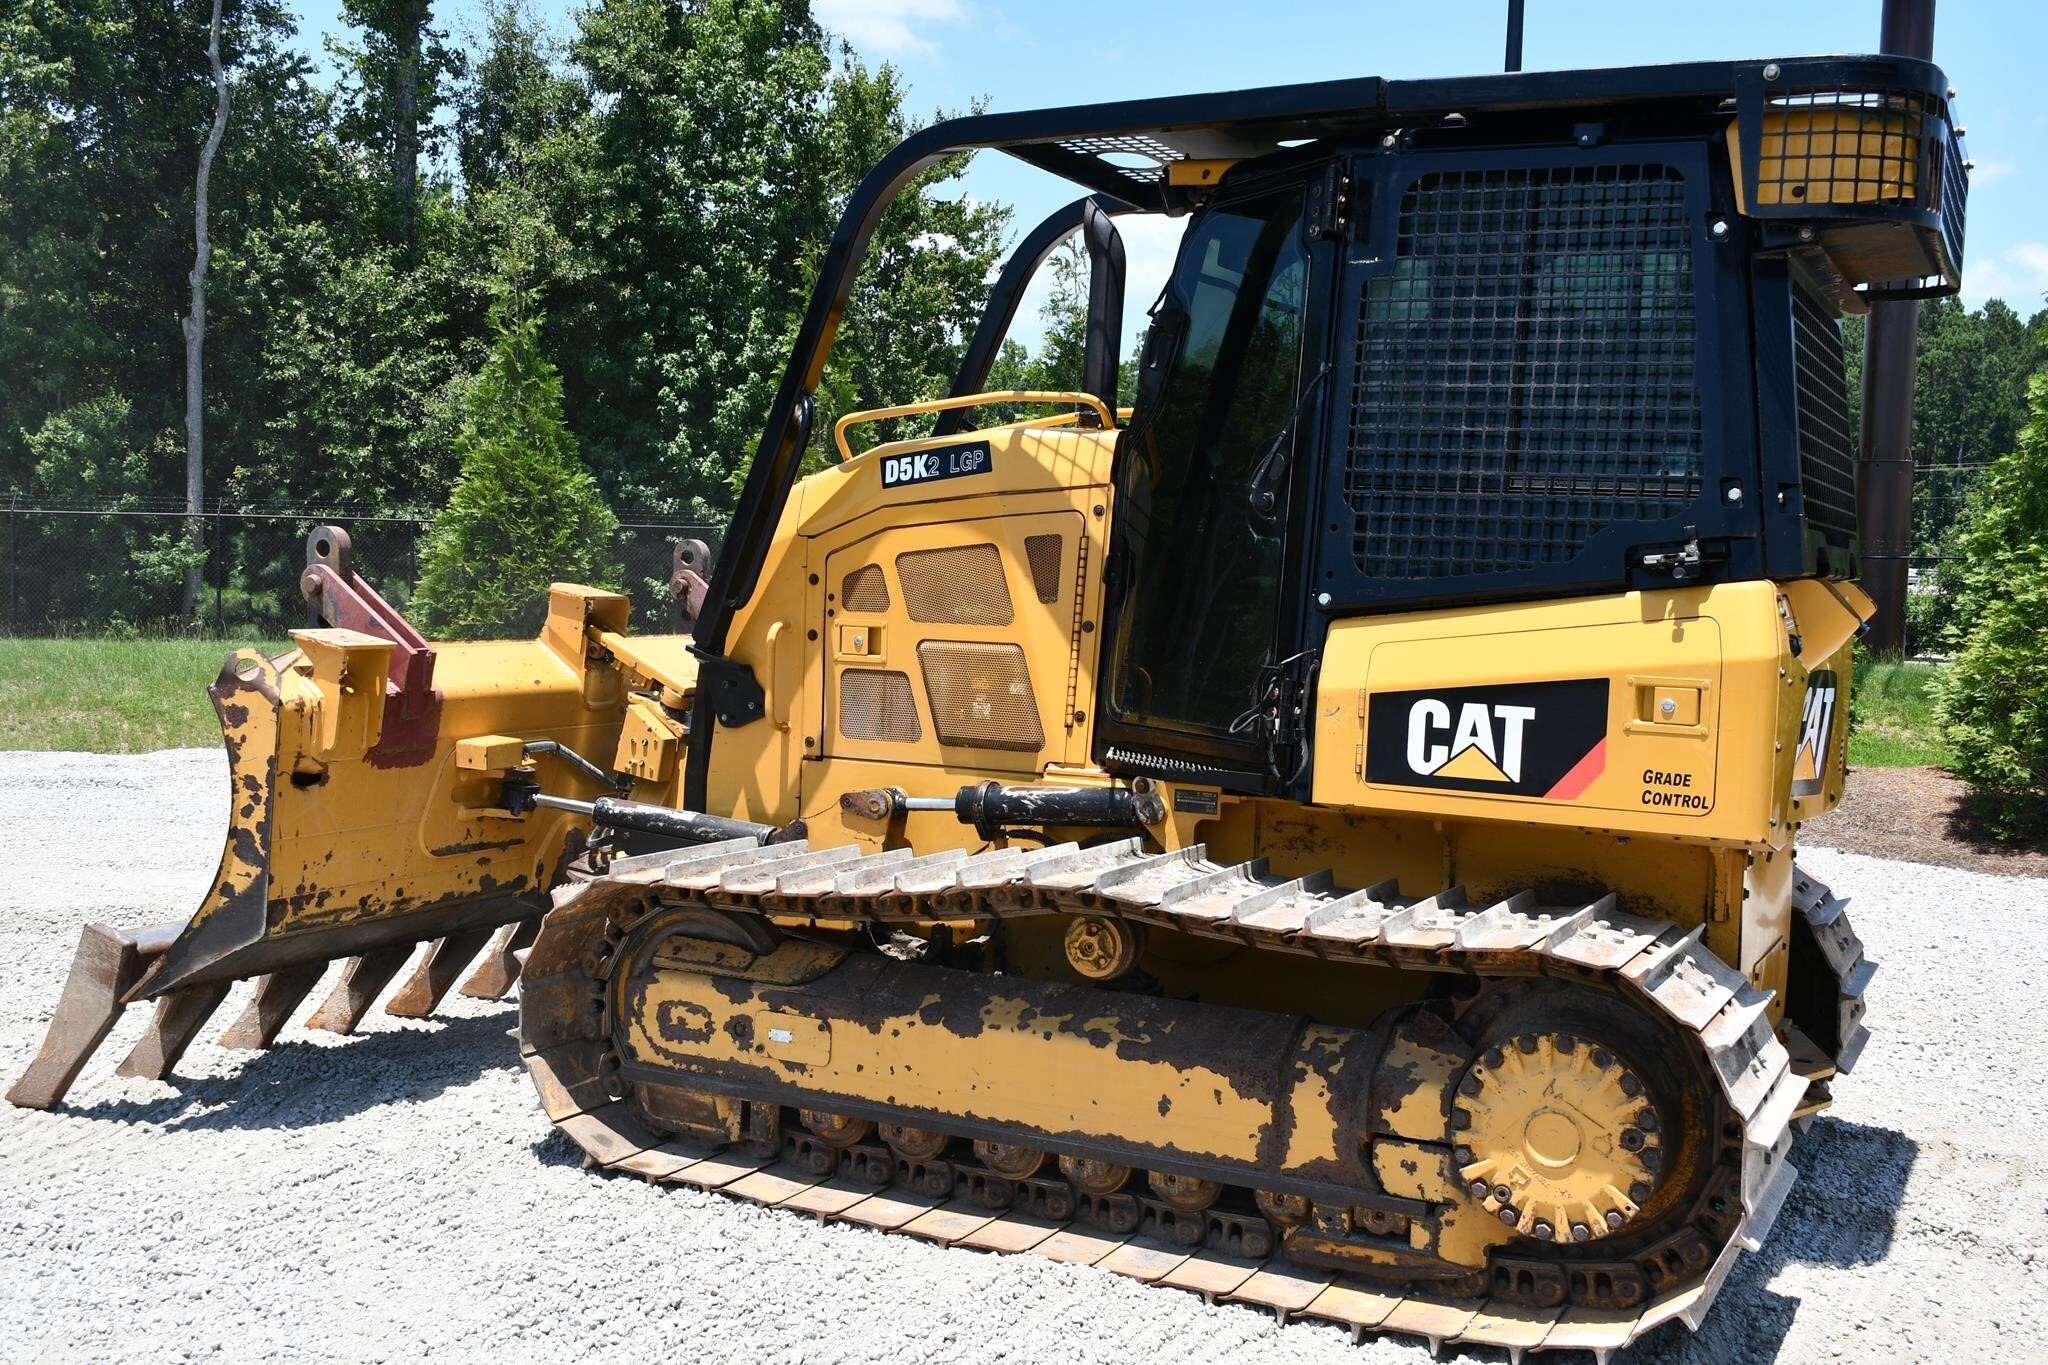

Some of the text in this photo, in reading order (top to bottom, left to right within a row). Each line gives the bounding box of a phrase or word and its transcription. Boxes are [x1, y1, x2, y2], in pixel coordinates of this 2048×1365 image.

[885, 449, 984, 484] D5K2 LGP
[1406, 698, 1536, 783] CAT
[1642, 769, 1692, 787] GRADE
[1641, 789, 1709, 810] CONTROL
